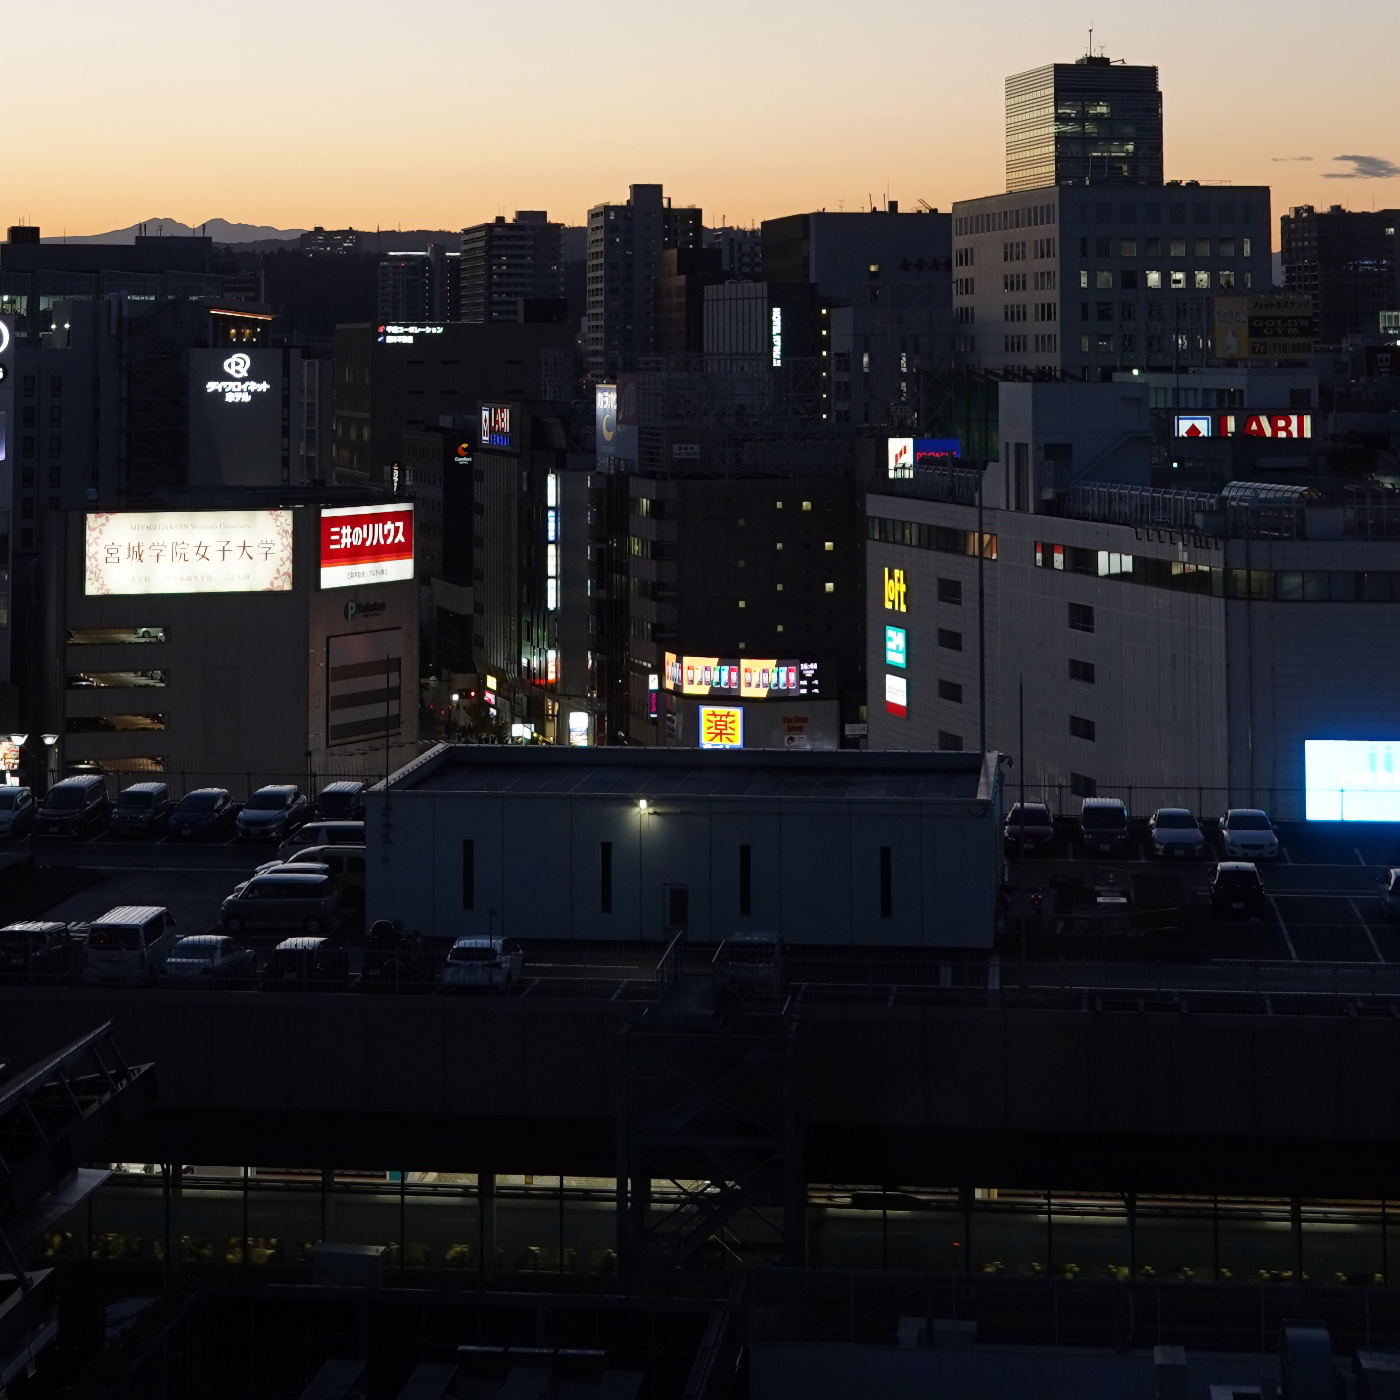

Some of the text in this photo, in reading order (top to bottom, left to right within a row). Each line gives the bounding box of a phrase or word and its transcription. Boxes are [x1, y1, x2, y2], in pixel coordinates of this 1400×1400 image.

[1252, 319, 1309, 327] GOLD'S
[225, 391, 252, 403] ホテル
[490, 407, 510, 433] LABI
[1219, 414, 1311, 438] LABI
[329, 520, 406, 550] 三井のリハウス
[104, 539, 276, 564] 宮城学院女子大学
[706, 710, 736, 743] 薬
